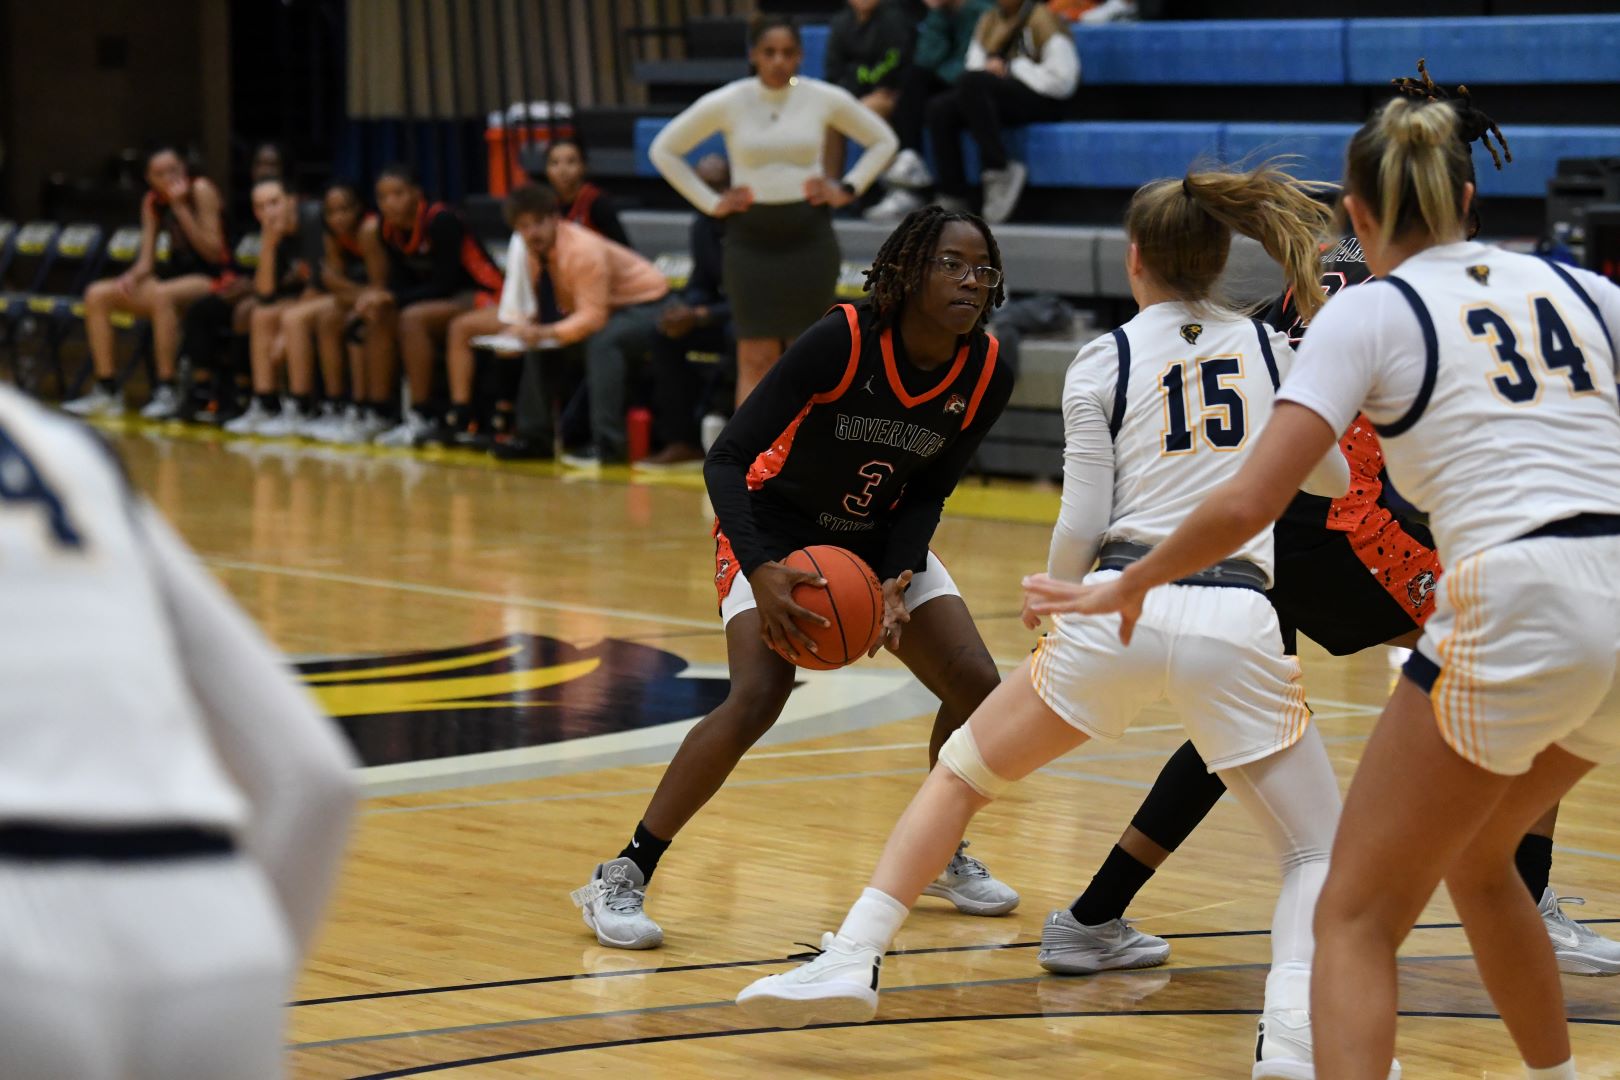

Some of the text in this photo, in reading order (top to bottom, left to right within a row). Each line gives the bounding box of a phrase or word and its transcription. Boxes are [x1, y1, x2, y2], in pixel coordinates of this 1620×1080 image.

[1459, 291, 1601, 409] 34
[835, 413, 947, 457] GOVERNORS
[1157, 353, 1249, 457] 15
